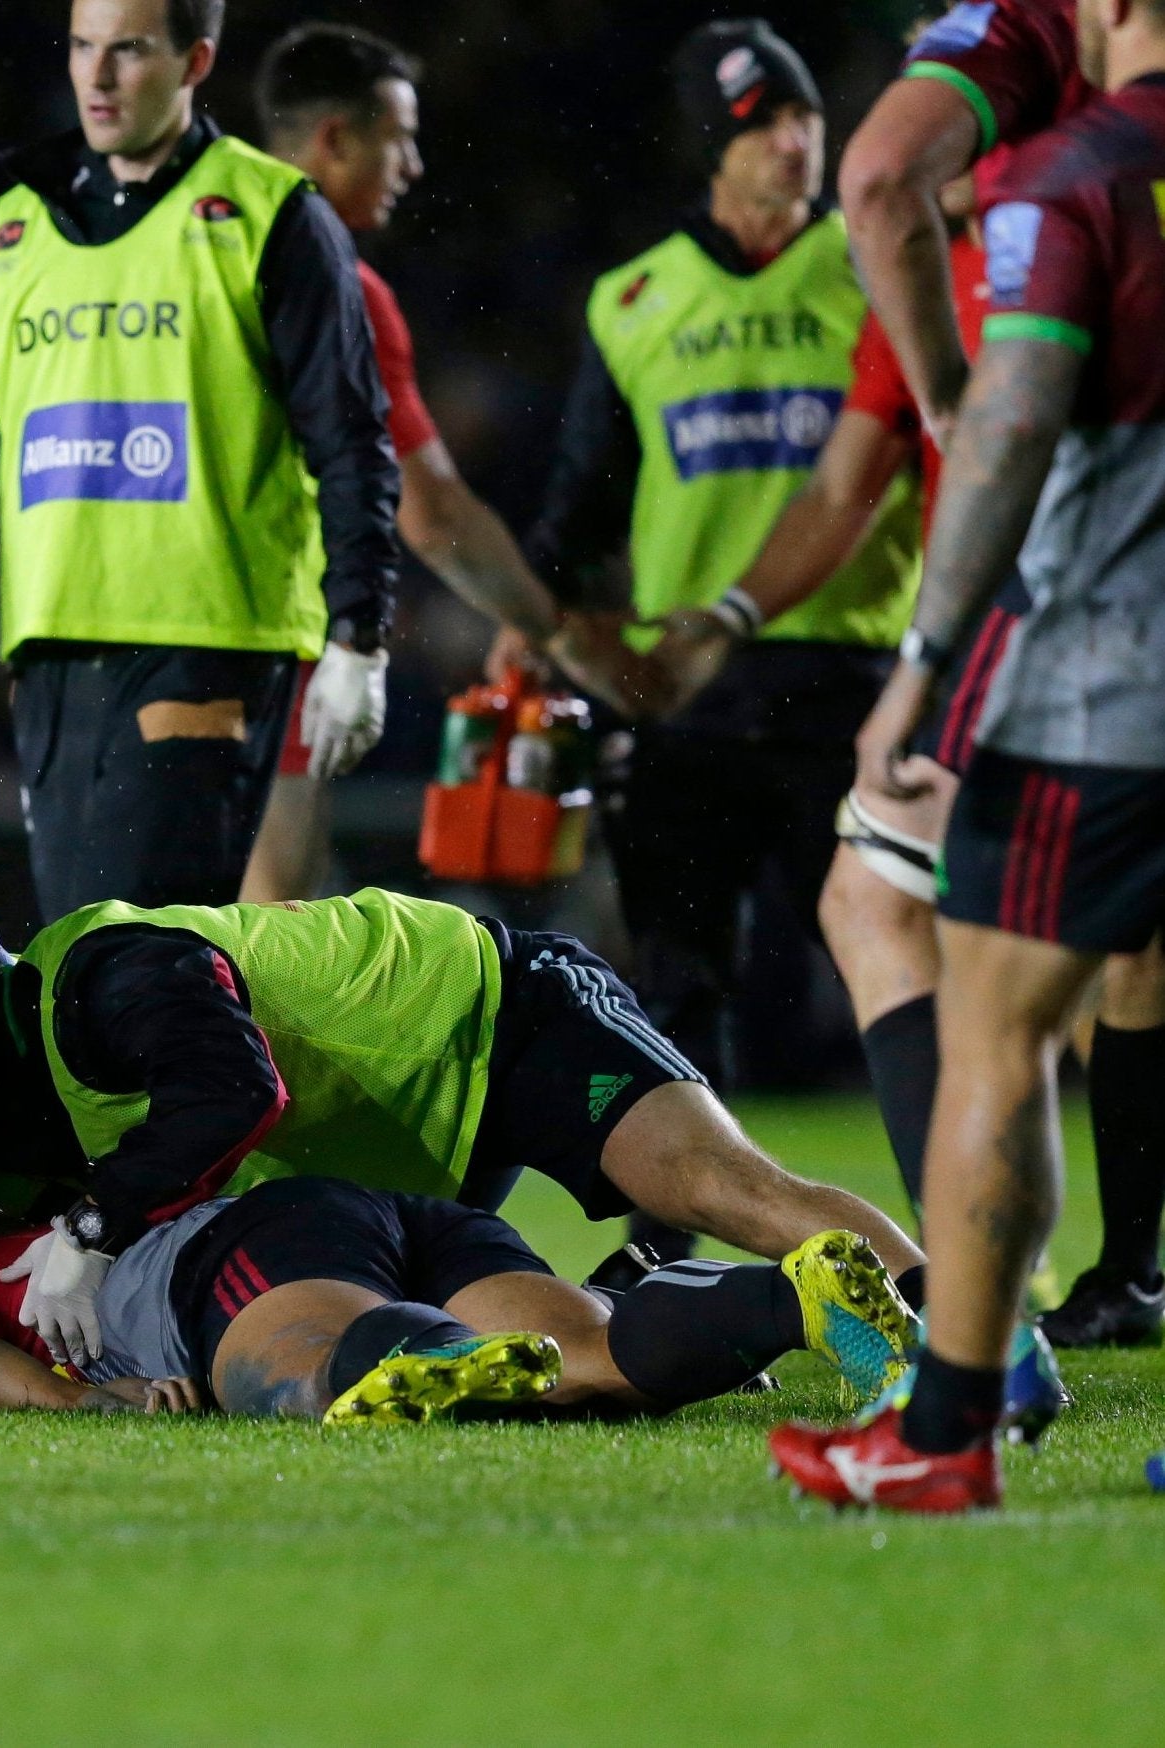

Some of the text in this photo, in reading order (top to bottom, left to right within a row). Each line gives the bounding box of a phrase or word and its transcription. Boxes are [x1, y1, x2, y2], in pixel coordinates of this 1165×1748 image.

[15, 301, 181, 353] DOCTOR
[670, 310, 825, 358] WATER
[21, 434, 117, 477] Allianz
[590, 1073, 634, 1123] adidas
